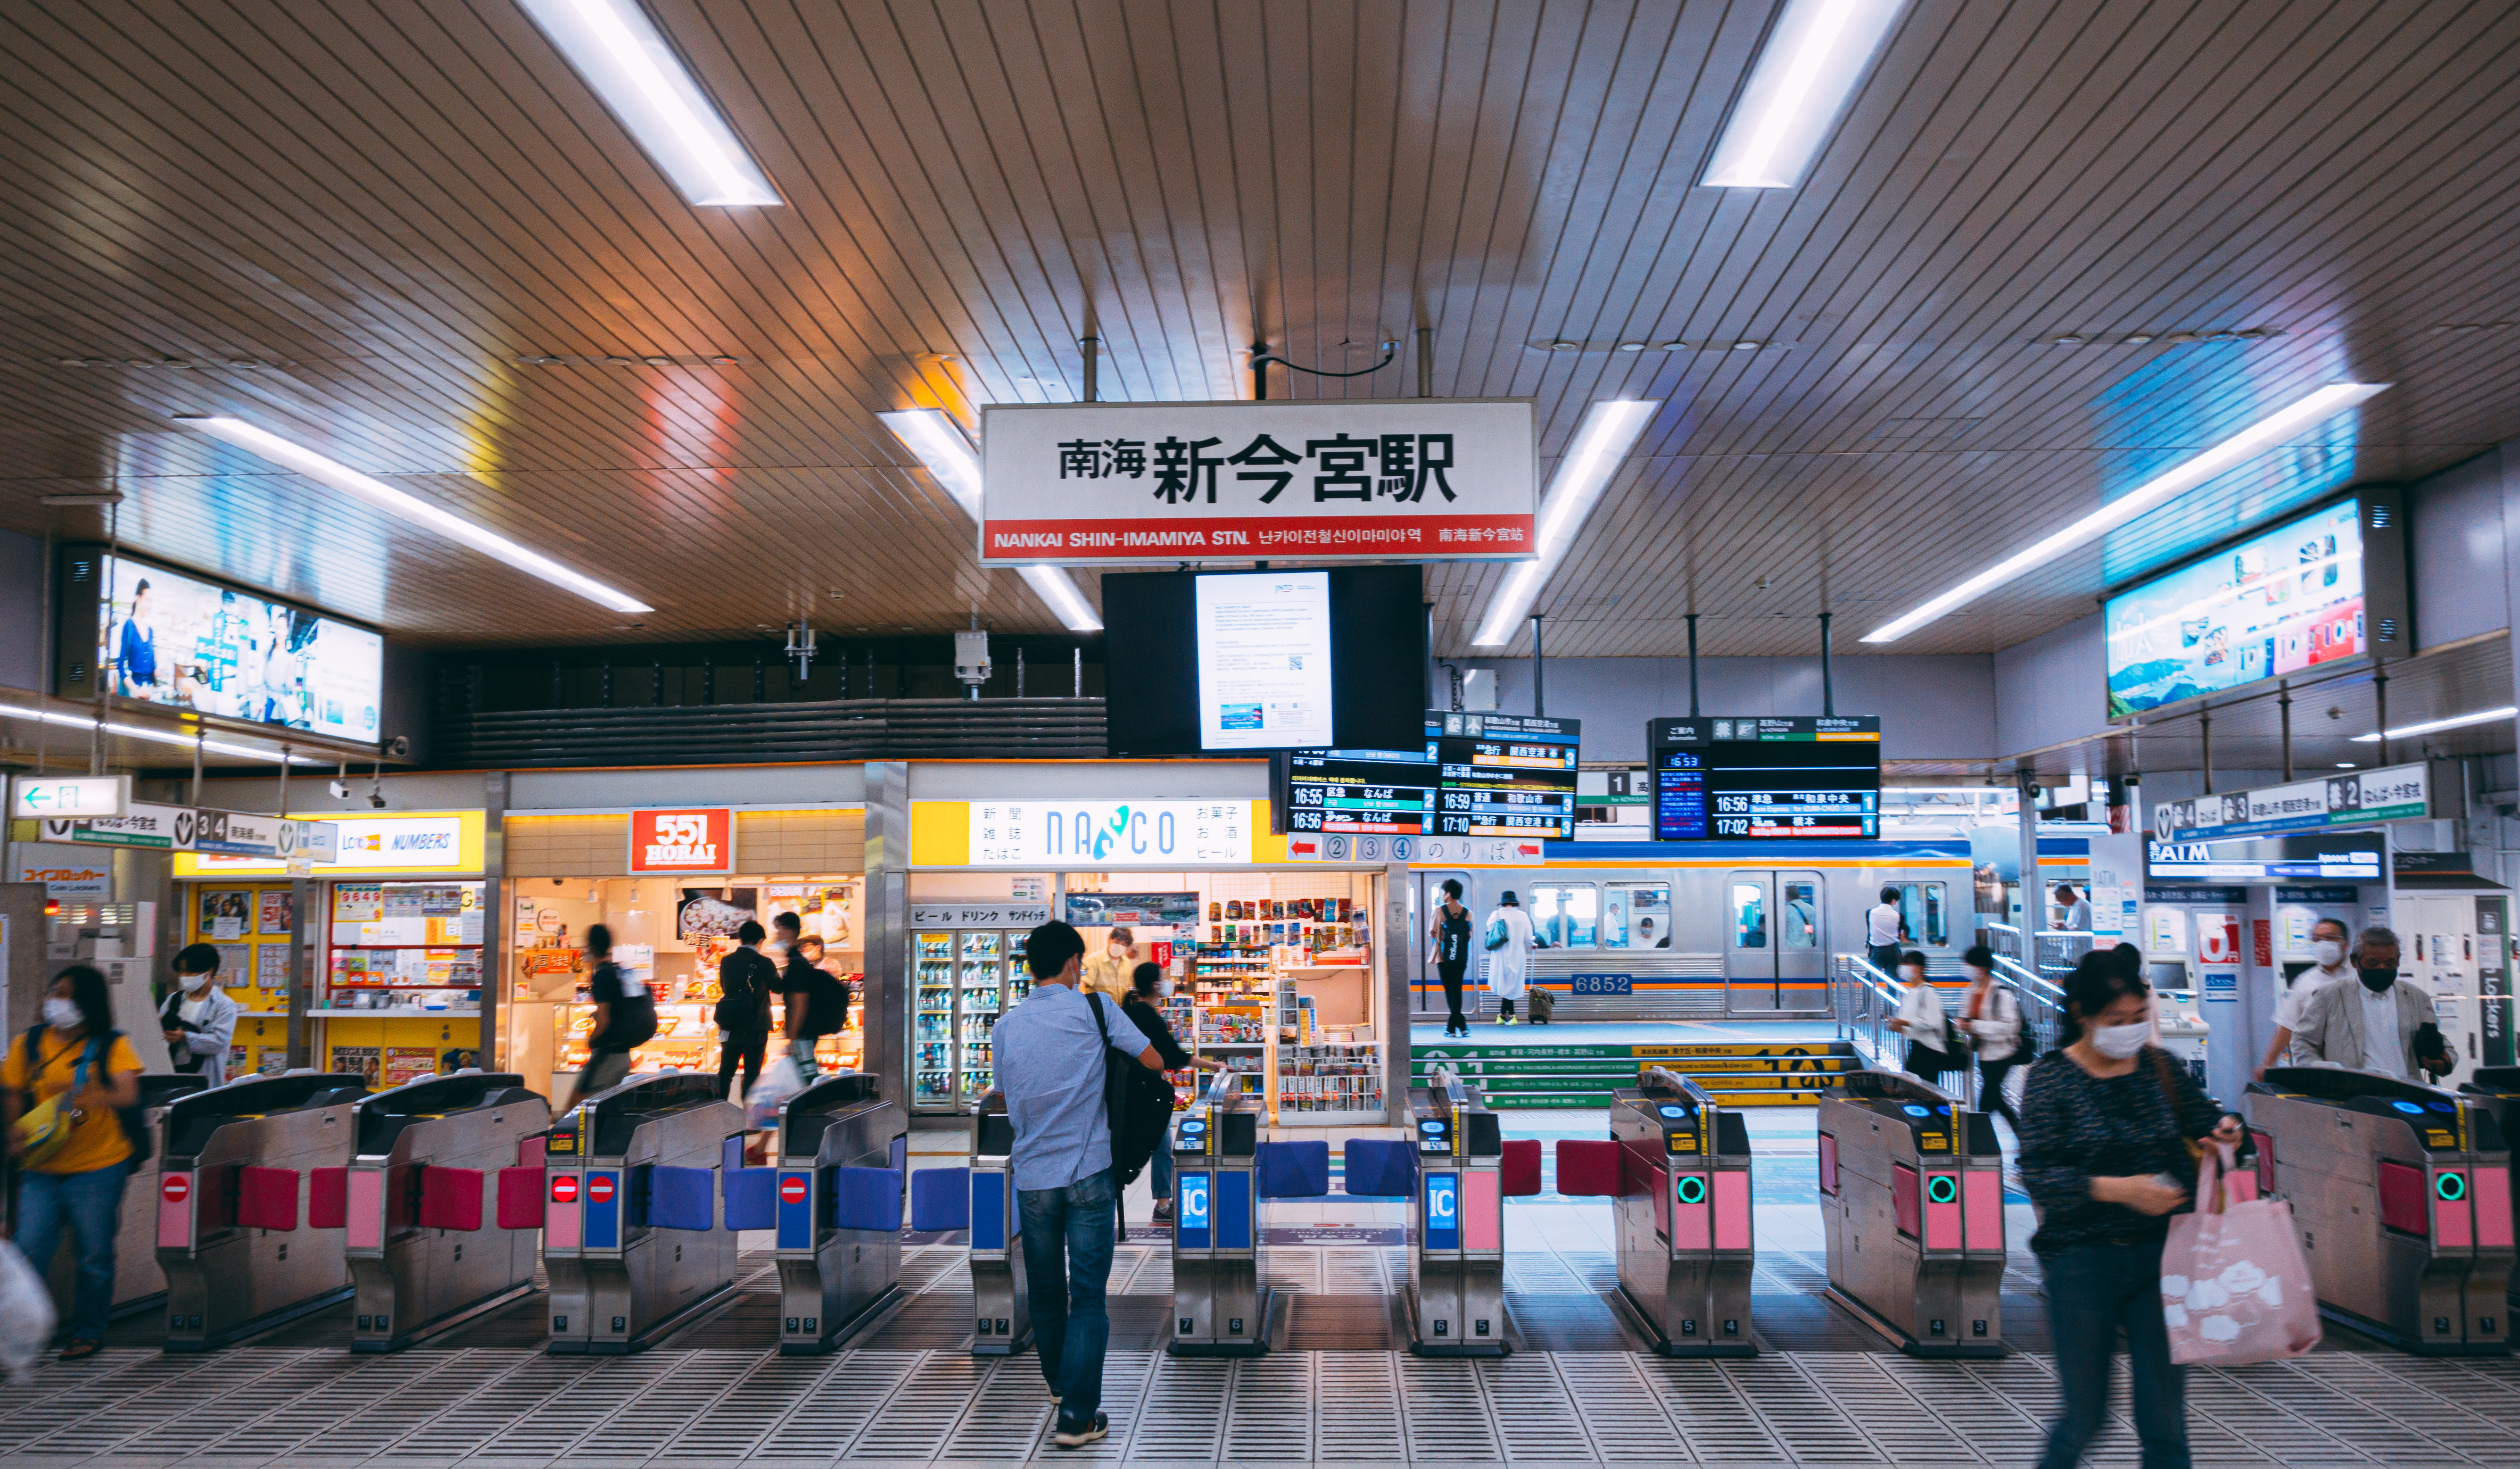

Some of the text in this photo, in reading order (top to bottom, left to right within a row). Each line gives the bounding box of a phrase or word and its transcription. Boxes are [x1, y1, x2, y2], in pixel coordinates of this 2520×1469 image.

[1058, 433, 1458, 504] 南海 新今宮駅
[995, 530, 1250, 548] NANKAI SHIN-IMAMIYA STN.
[1439, 528, 1525, 542] 南海新今宮站
[1428, 745, 1437, 759] 2
[1566, 752, 1575, 766] 3
[1613, 777, 1622, 791] 1
[1295, 788, 1434, 807] 16:55 区急 なんば 2
[2347, 781, 2357, 805] 2
[1444, 792, 1572, 812] 16:59 普通 和歌山市 3
[1717, 797, 1748, 812] 16:56
[1752, 794, 1773, 804] 準急
[1805, 794, 1849, 804] 和泉中央
[1864, 797, 1873, 810] 1
[2238, 797, 2247, 818] 3
[983, 807, 1021, 821] 新聞
[1196, 807, 1238, 820] お菓子
[2186, 805, 2194, 823] 4
[199, 816, 225, 837] 3 4
[656, 814, 707, 845] 551
[1293, 813, 1321, 829] 16:56
[1363, 813, 1392, 822] なんば
[1423, 817, 1432, 832] 4
[1443, 817, 1469, 832] 17:10
[1562, 821, 1571, 834] 3
[1717, 819, 1748, 834] 17:02
[1793, 816, 1815, 826] 橋本
[1864, 819, 1873, 832] 1
[983, 827, 1021, 840] 雑誌
[1196, 826, 1237, 839] お酒
[391, 833, 450, 850] NUMBERS
[645, 844, 716, 861] HORAI
[983, 847, 1021, 860] たばこ
[1196, 846, 1236, 859] ビール
[1429, 841, 1507, 861] のりば
[24, 869, 106, 881] コインロッカー
[915, 911, 1046, 921] ビール ドリンク サンドイッチ
[1449, 934, 1458, 960] adidas
[1576, 977, 1628, 992] 6852
[1182, 1189, 1207, 1215] IC
[1429, 1190, 1454, 1216] IC
[361, 1316, 369, 1325] 11
[614, 1318, 622, 1328] 9
[788, 1319, 796, 1328] 9
[806, 1319, 814, 1328] 8
[981, 1320, 989, 1329] 8
[999, 1320, 1006, 1329] 7
[1183, 1319, 1190, 1328] 7
[1232, 1320, 1240, 1329] 6
[1437, 1321, 1445, 1330] 6
[1478, 1321, 1486, 1330] 5
[1685, 1321, 1693, 1330] 5
[1727, 1321, 1735, 1330] 4
[1933, 1321, 1941, 1330] 4
[1976, 1322, 1984, 1331] 3
